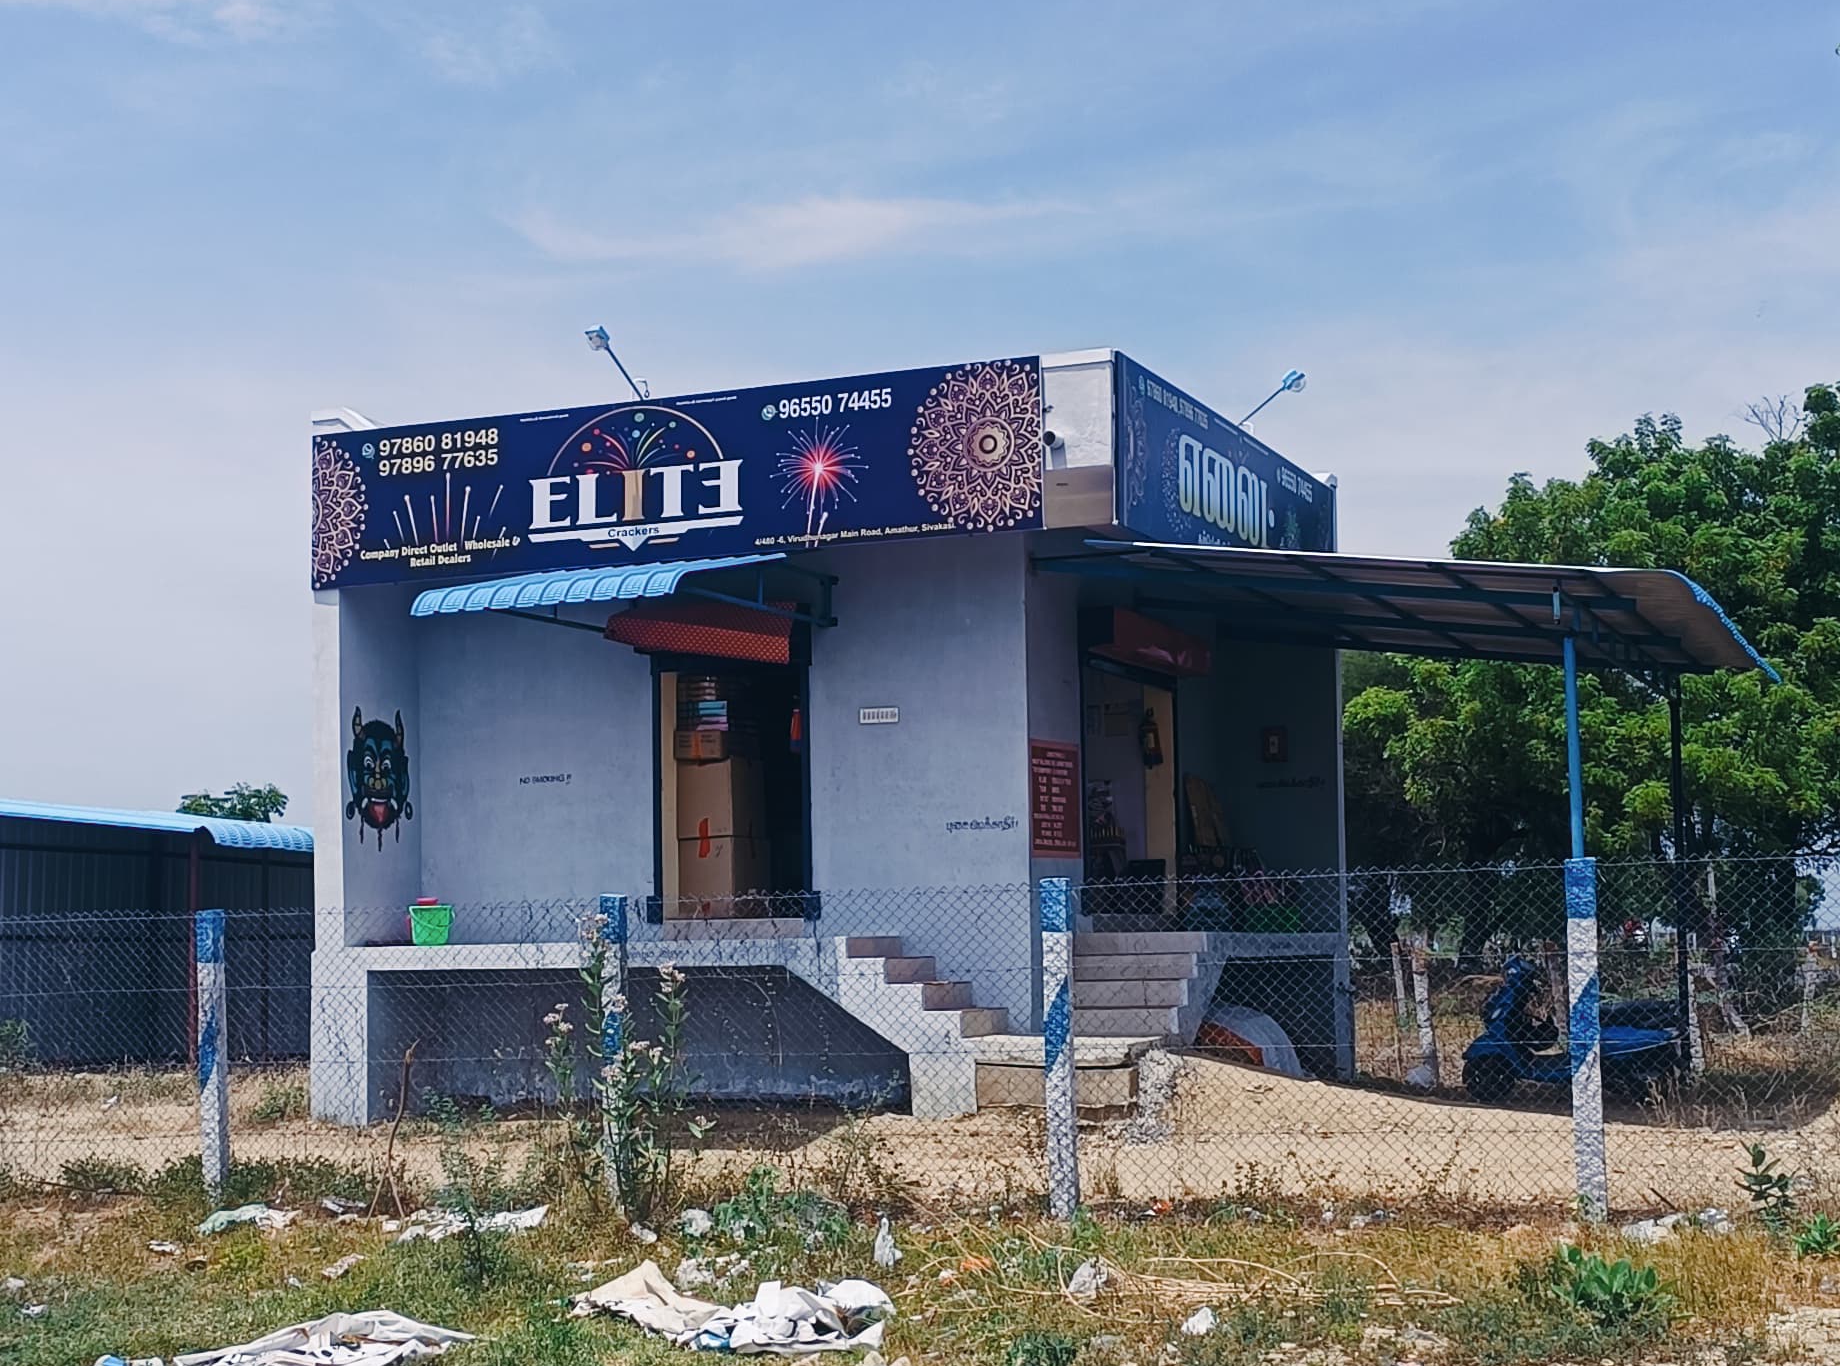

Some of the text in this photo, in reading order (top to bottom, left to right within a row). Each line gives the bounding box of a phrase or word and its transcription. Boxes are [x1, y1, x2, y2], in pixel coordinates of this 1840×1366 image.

[779, 388, 892, 419] 96550 74455
[379, 428, 498, 456] 97860 81948
[379, 449, 498, 476] 97896 77635
[528, 459, 743, 529] ELITE
[608, 525, 660, 538] Crackers
[840, 530, 859, 539] Main
[360, 547, 399, 561] Company
[401, 543, 428, 556] Direct
[430, 541, 457, 553] Outlet
[465, 536, 510, 550] Wholesale
[410, 553, 471, 568] Retail Dealers
